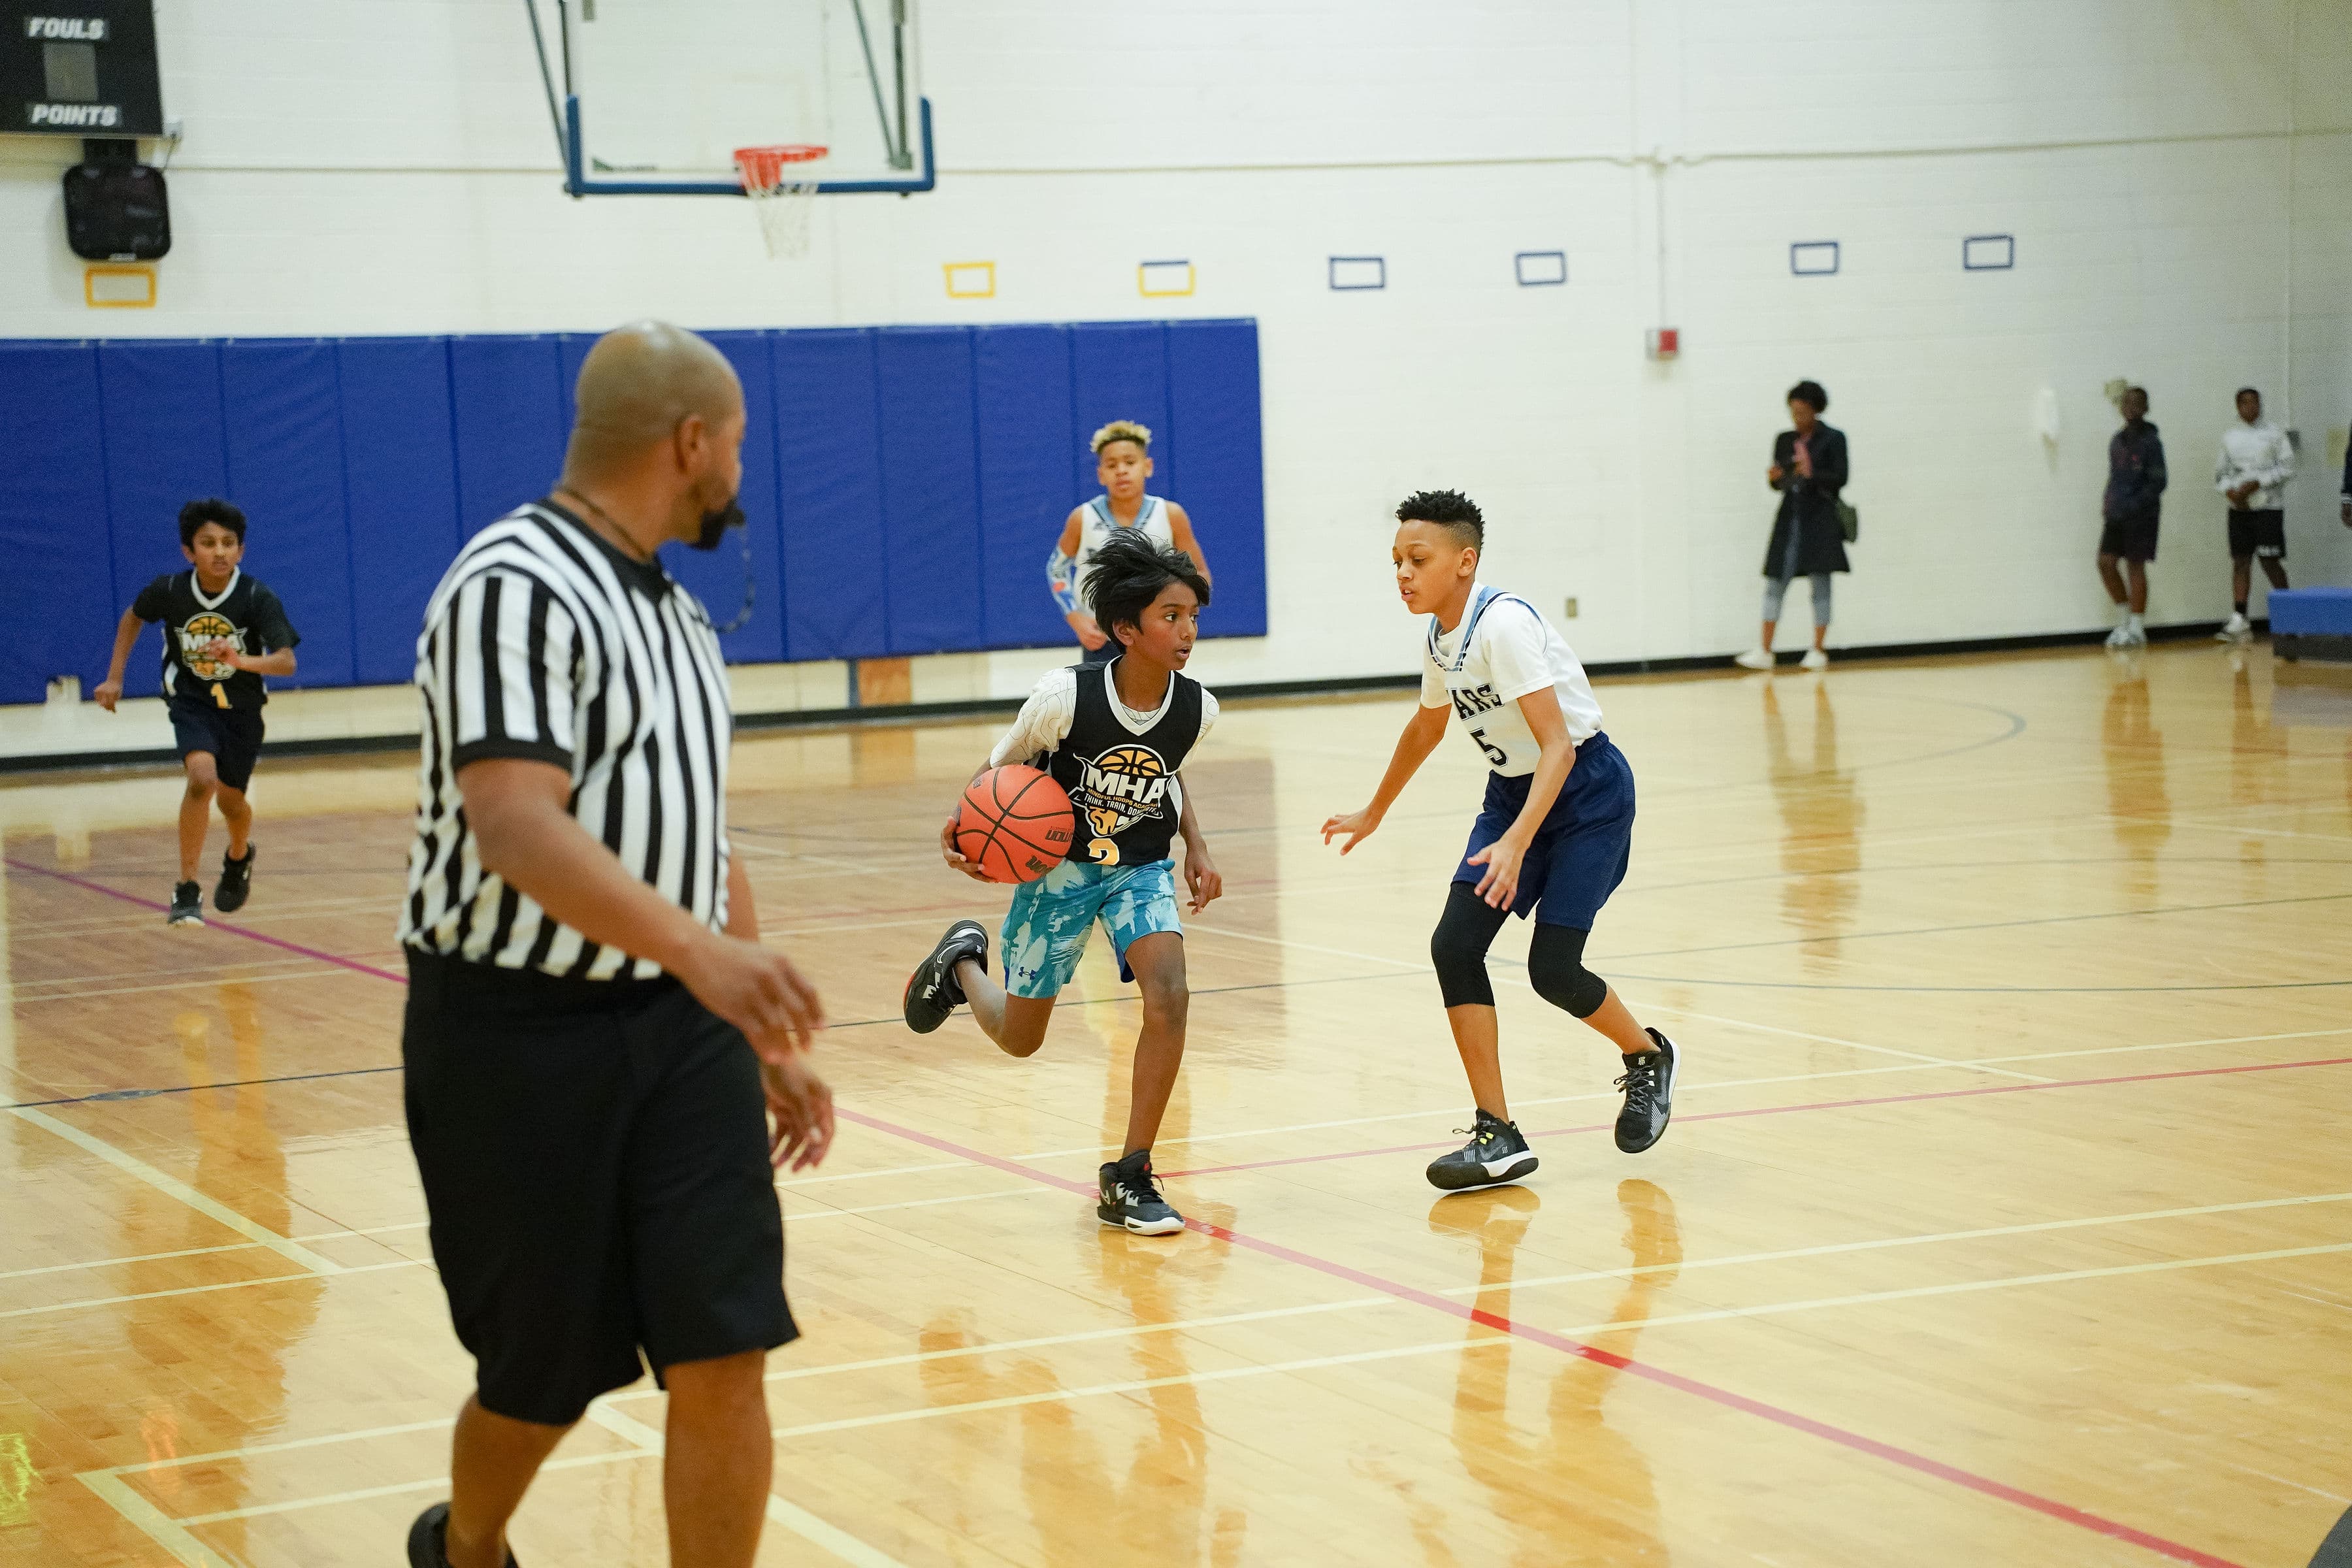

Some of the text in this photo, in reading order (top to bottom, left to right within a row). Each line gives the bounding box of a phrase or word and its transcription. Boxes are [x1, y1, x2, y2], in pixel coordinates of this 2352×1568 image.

[29, 17, 105, 39] FOULS
[31, 104, 118, 126] POINTS
[210, 682, 233, 709] 1
[1446, 683, 1505, 721] ARS
[1469, 727, 1509, 767] 5
[1086, 763, 1168, 805] MHA
[1087, 788, 1112, 800] MINDFUL
[1113, 796, 1134, 806] HOOPS
[1084, 793, 1104, 807] THINK.
[1107, 801, 1126, 813] TRAIN.
[1087, 838, 1120, 865] 2
